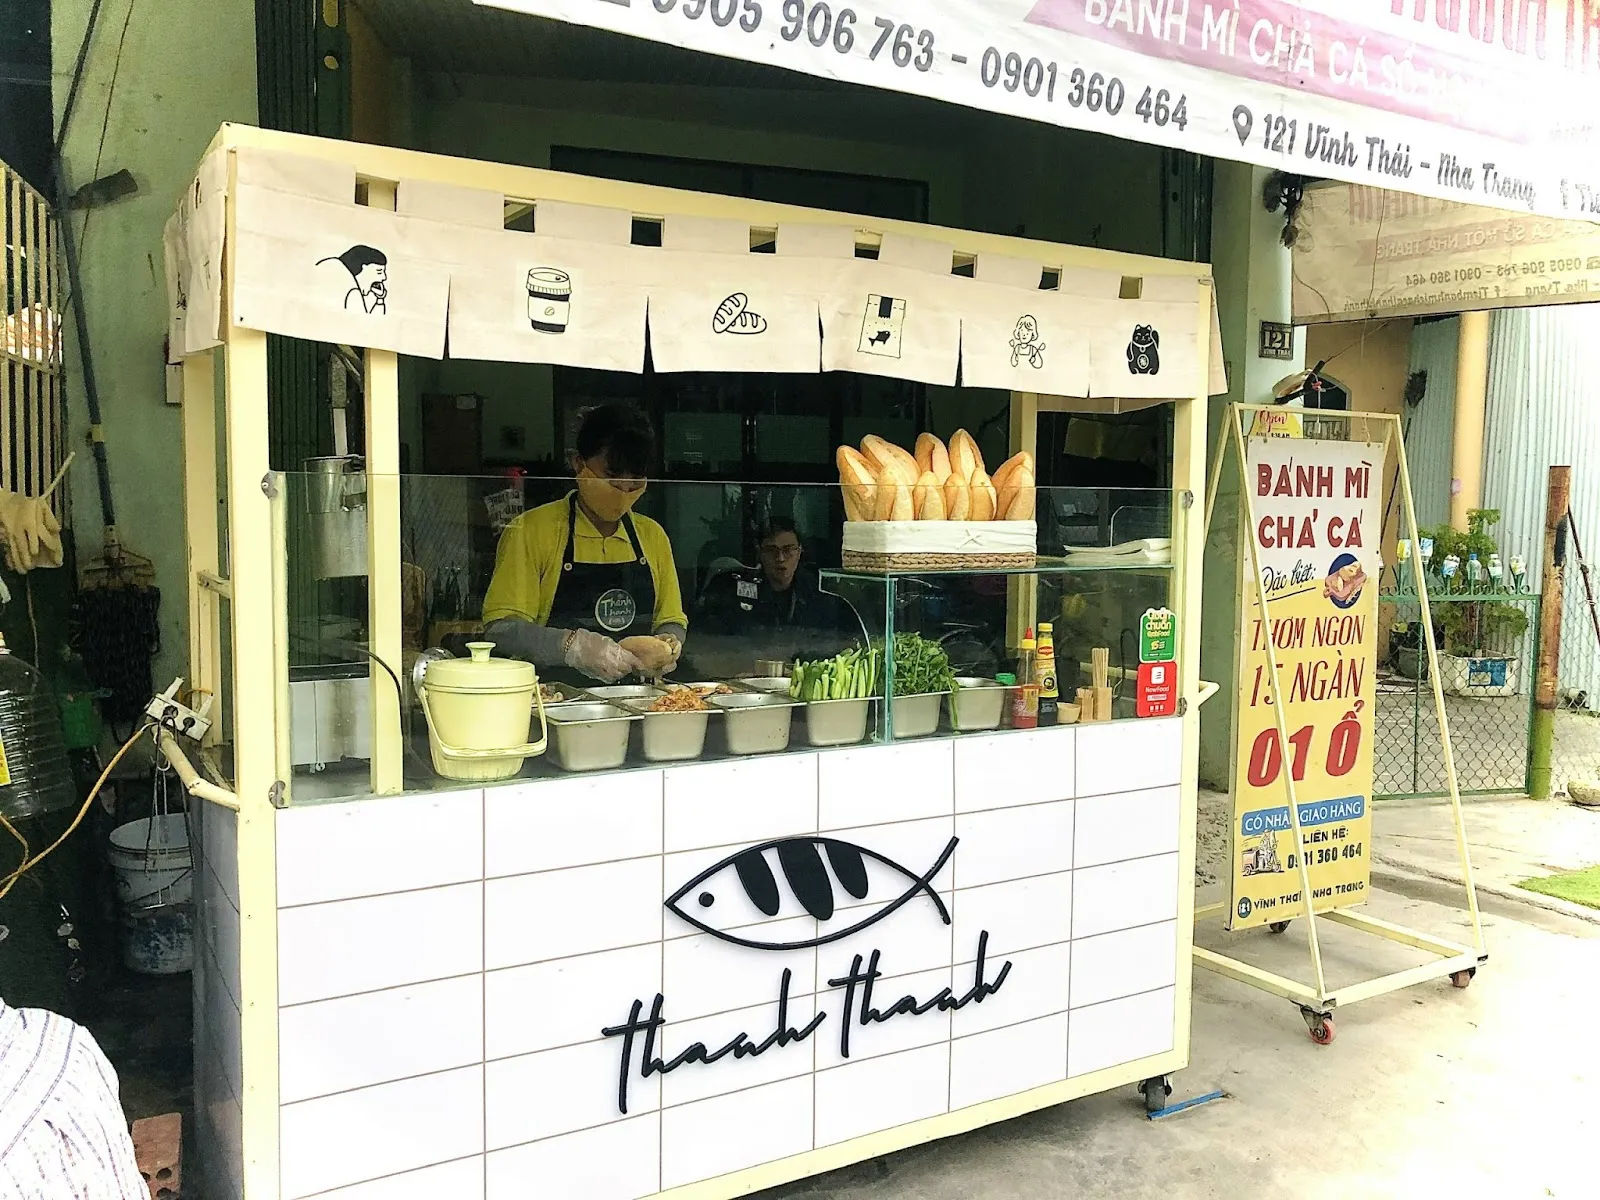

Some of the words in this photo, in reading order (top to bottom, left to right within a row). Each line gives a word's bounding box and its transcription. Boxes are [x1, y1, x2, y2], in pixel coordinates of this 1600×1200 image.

[1201, 0, 1240, 57] MÌ
[1328, 35, 1369, 87] CÁ
[781, 0, 857, 54] 906
[869, 16, 934, 72] 763
[981, 46, 1057, 102] 0901
[1067, 68, 1125, 116] 360
[1135, 85, 1188, 132] 464
[1263, 113, 1297, 155] 121
[1305, 122, 1358, 167] Vĩnh
[1365, 136, 1413, 179] Thái
[1437, 152, 1475, 191] Nha
[1482, 162, 1536, 210] Trang
[1264, 331, 1290, 349] 121
[1257, 456, 1333, 497] BÁNH
[1345, 460, 1372, 498] MÌ
[1258, 508, 1318, 548] CHẢ
[1327, 508, 1363, 547] CÁ
[1290, 559, 1317, 588] biệt:
[1312, 615, 1366, 648] NGON
[1290, 650, 1365, 702] NGÀN
[1248, 725, 1314, 787] 01
[1326, 700, 1364, 776] Ổ
[1245, 813, 1263, 831] CÓ
[1265, 810, 1291, 829] NHẬ
[1300, 806, 1328, 823] GIAO
[1330, 801, 1361, 818] HÀNG
[1303, 829, 1328, 845] LIÊN
[1317, 846, 1338, 864] 360
[1342, 843, 1362, 859] 464
[1254, 897, 1276, 910] VĨNH
